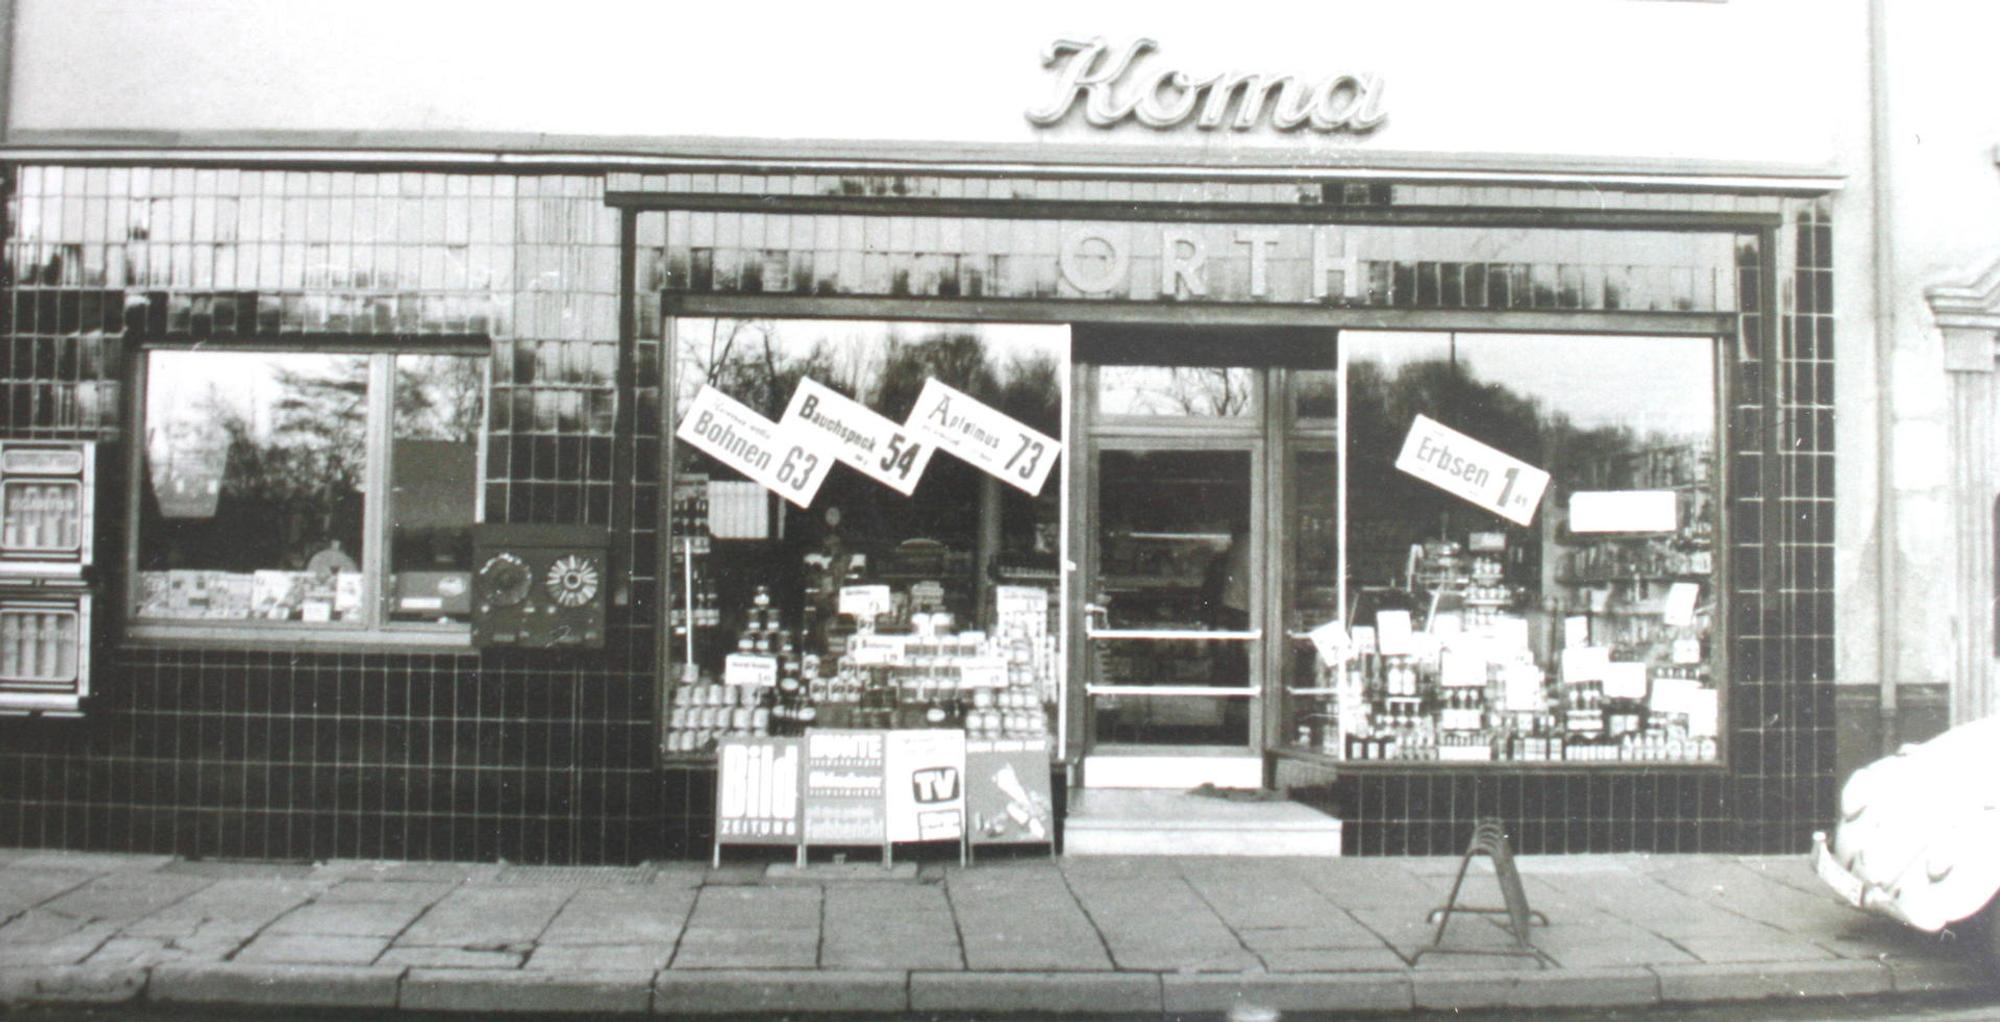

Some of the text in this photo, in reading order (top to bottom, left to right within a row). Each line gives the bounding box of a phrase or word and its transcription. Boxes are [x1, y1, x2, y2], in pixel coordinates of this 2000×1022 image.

[1024, 36, 1389, 134] Koma
[1058, 228, 1363, 298] ORTH
[693, 409, 772, 471] Bohnen
[776, 445, 819, 491] 63
[798, 393, 877, 452] Bauchspeck
[880, 432, 922, 480] 54
[1004, 433, 1045, 480] 73
[1416, 435, 1490, 488] Erbsen
[721, 744, 799, 818] Bild
[914, 769, 957, 800] TV
[720, 820, 797, 835] ZEITUNG
